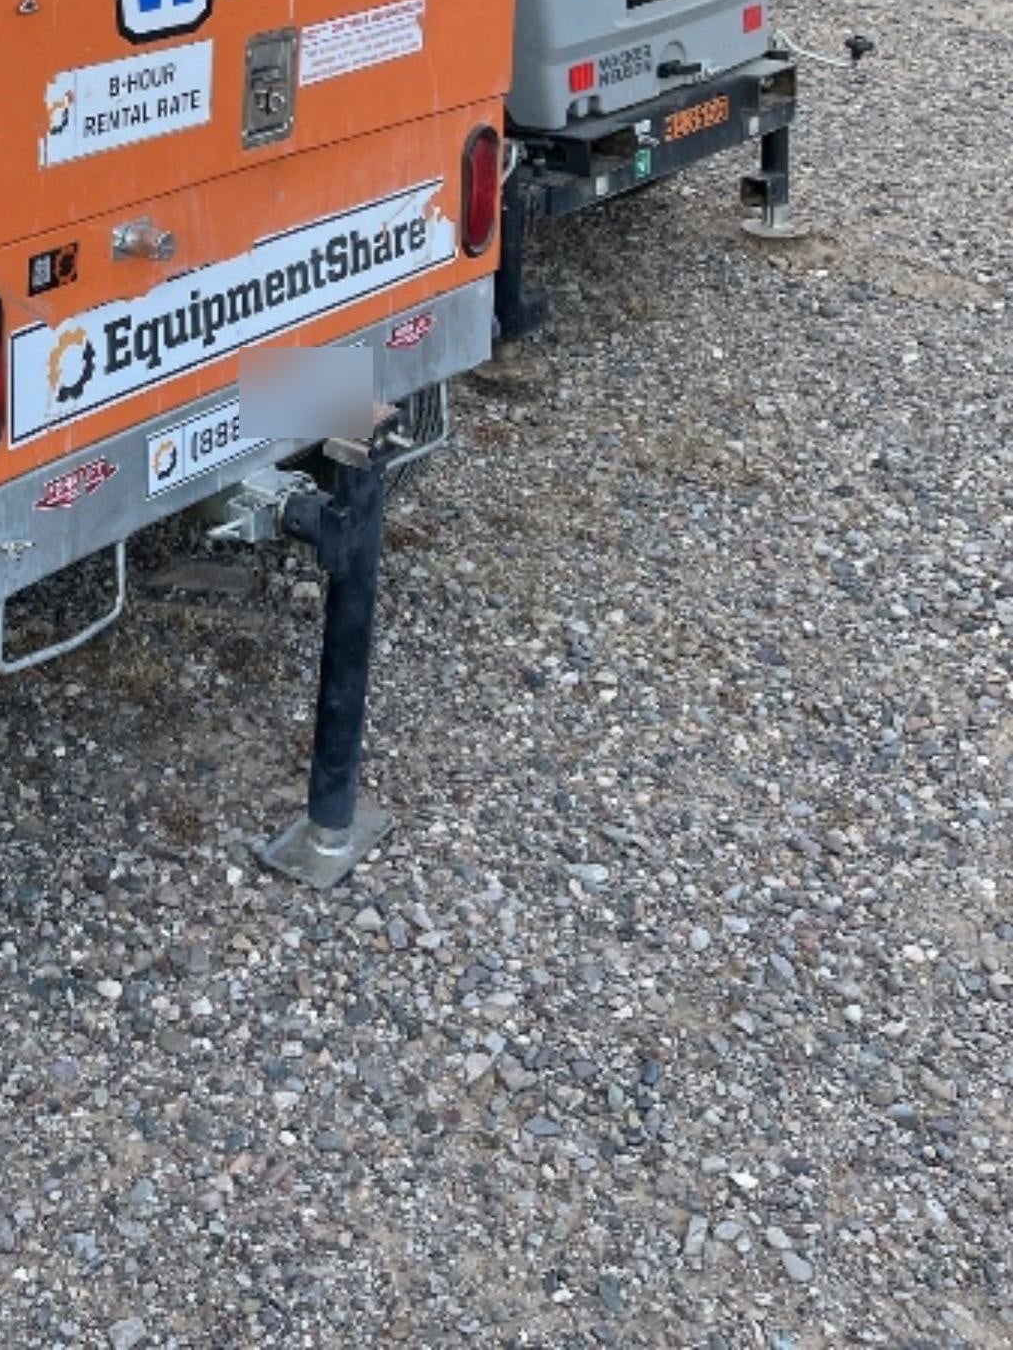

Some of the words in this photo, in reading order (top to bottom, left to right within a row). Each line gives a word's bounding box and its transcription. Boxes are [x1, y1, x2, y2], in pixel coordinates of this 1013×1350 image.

[83, 101, 152, 138] RENTAL
[157, 89, 201, 119] RATE
[104, 215, 427, 376] EquipmentShare
